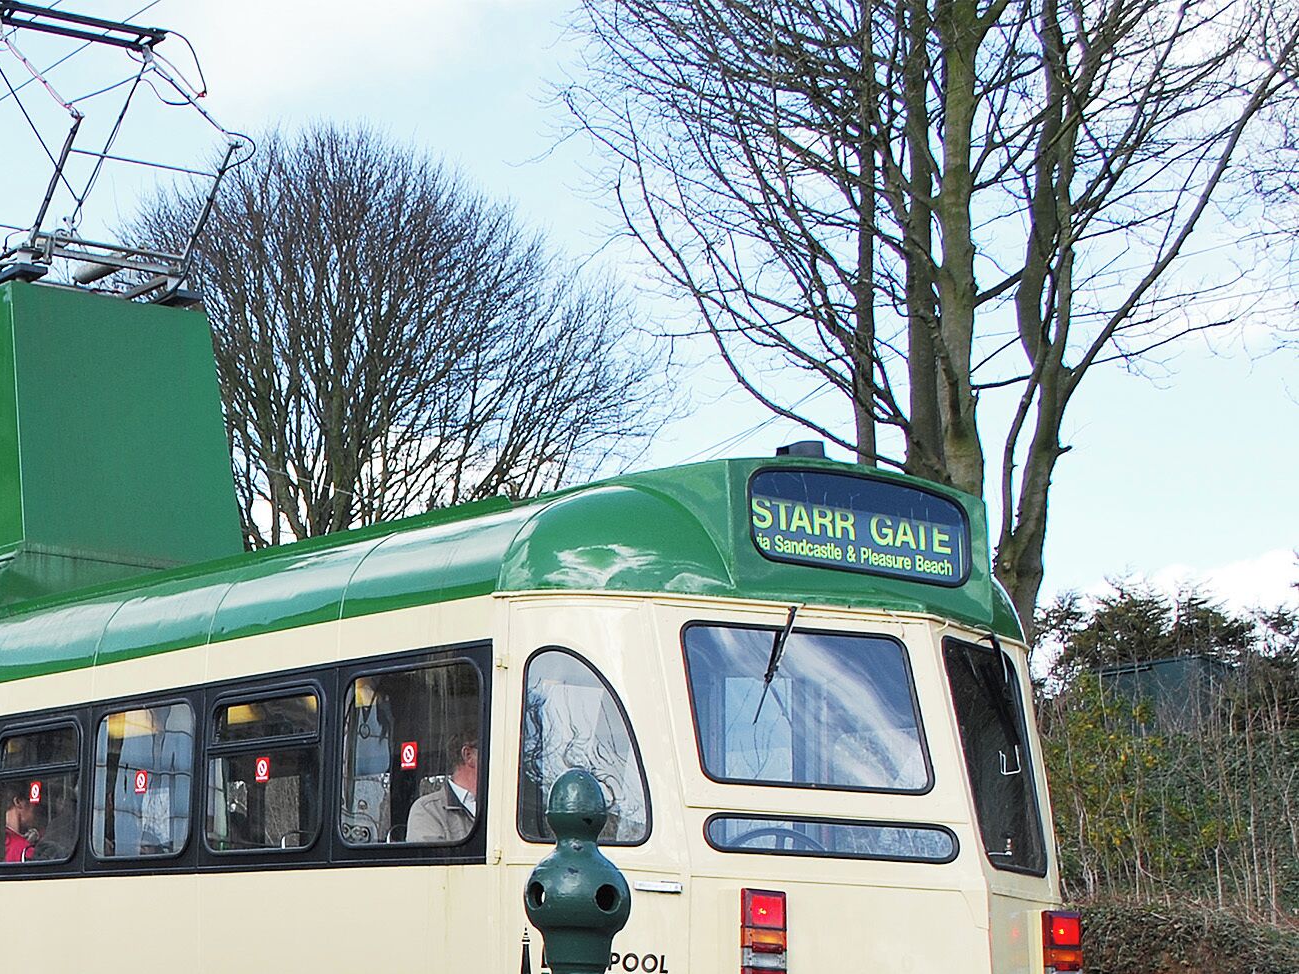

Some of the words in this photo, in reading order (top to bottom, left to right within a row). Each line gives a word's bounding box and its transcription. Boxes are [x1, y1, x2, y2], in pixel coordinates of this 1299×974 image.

[752, 497, 855, 540] STARR
[869, 513, 952, 554] GATE
[774, 534, 842, 560] Sandcastle
[846, 544, 857, 563] &
[860, 546, 912, 570] Pleasure
[914, 554, 953, 576] Beach
